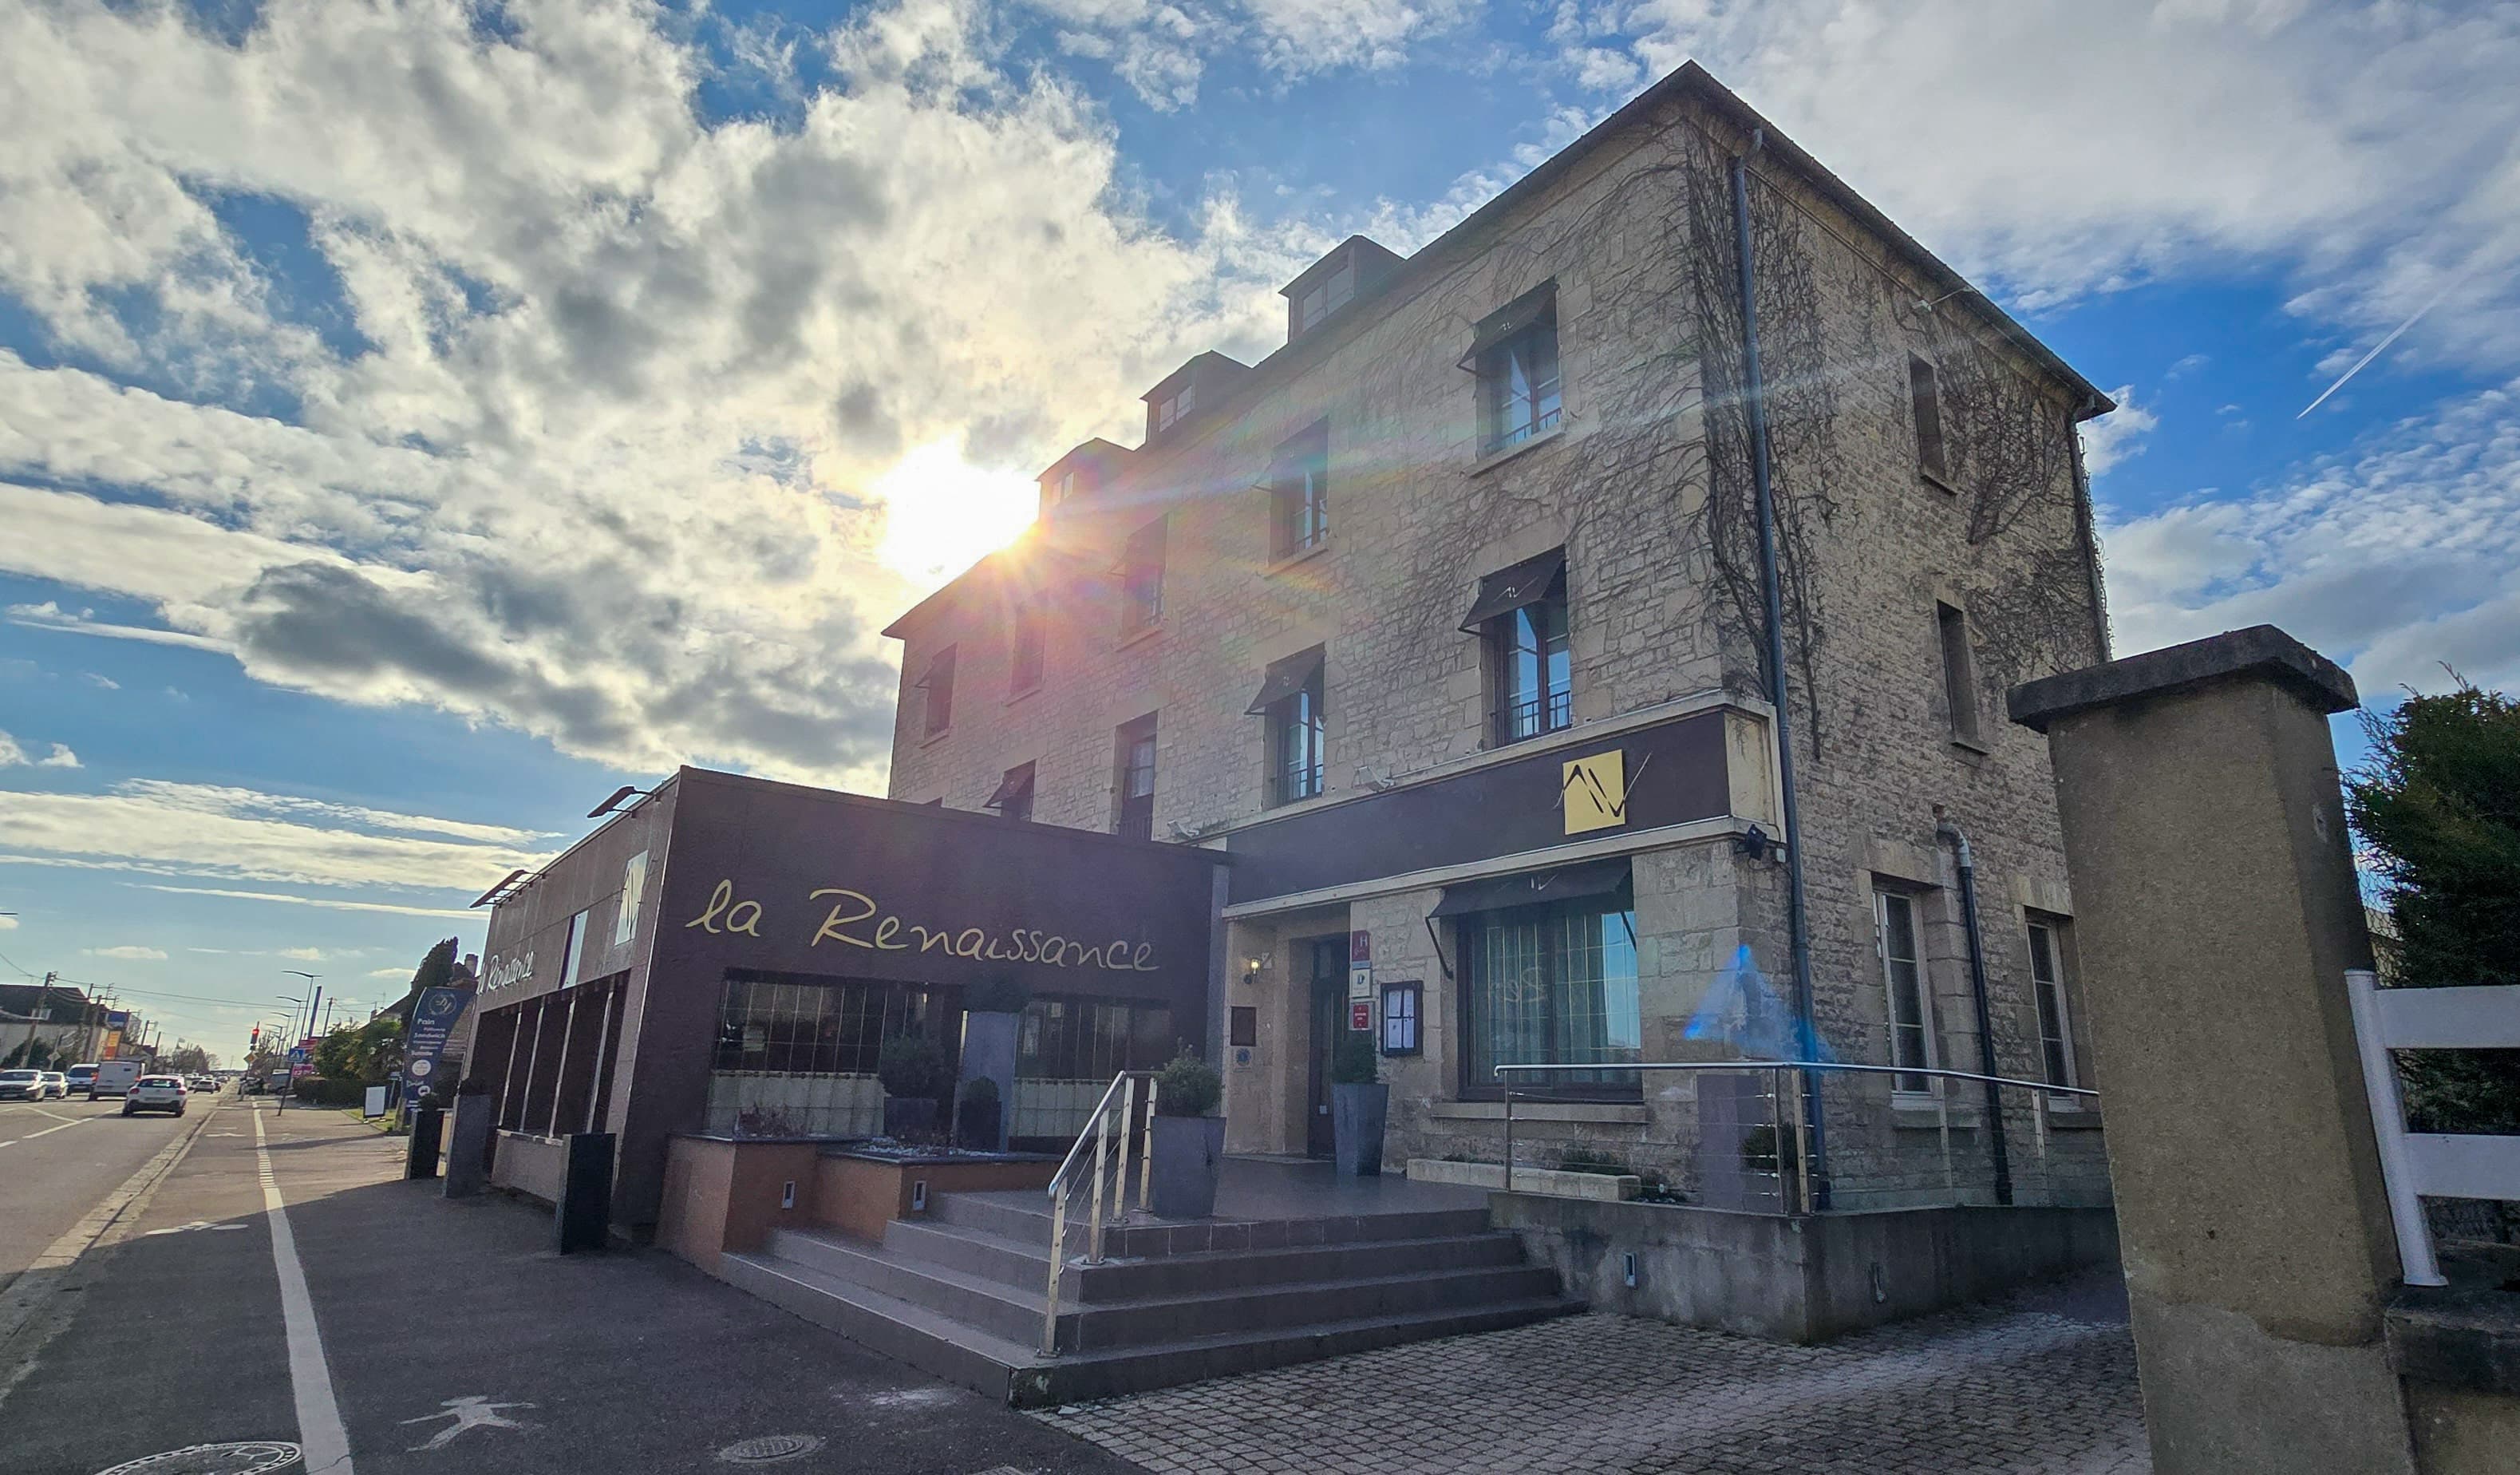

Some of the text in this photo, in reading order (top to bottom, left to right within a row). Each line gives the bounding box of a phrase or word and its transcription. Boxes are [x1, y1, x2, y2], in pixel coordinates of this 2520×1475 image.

[684, 879, 1160, 971] la Renaissance
[1360, 935, 1368, 947] H
